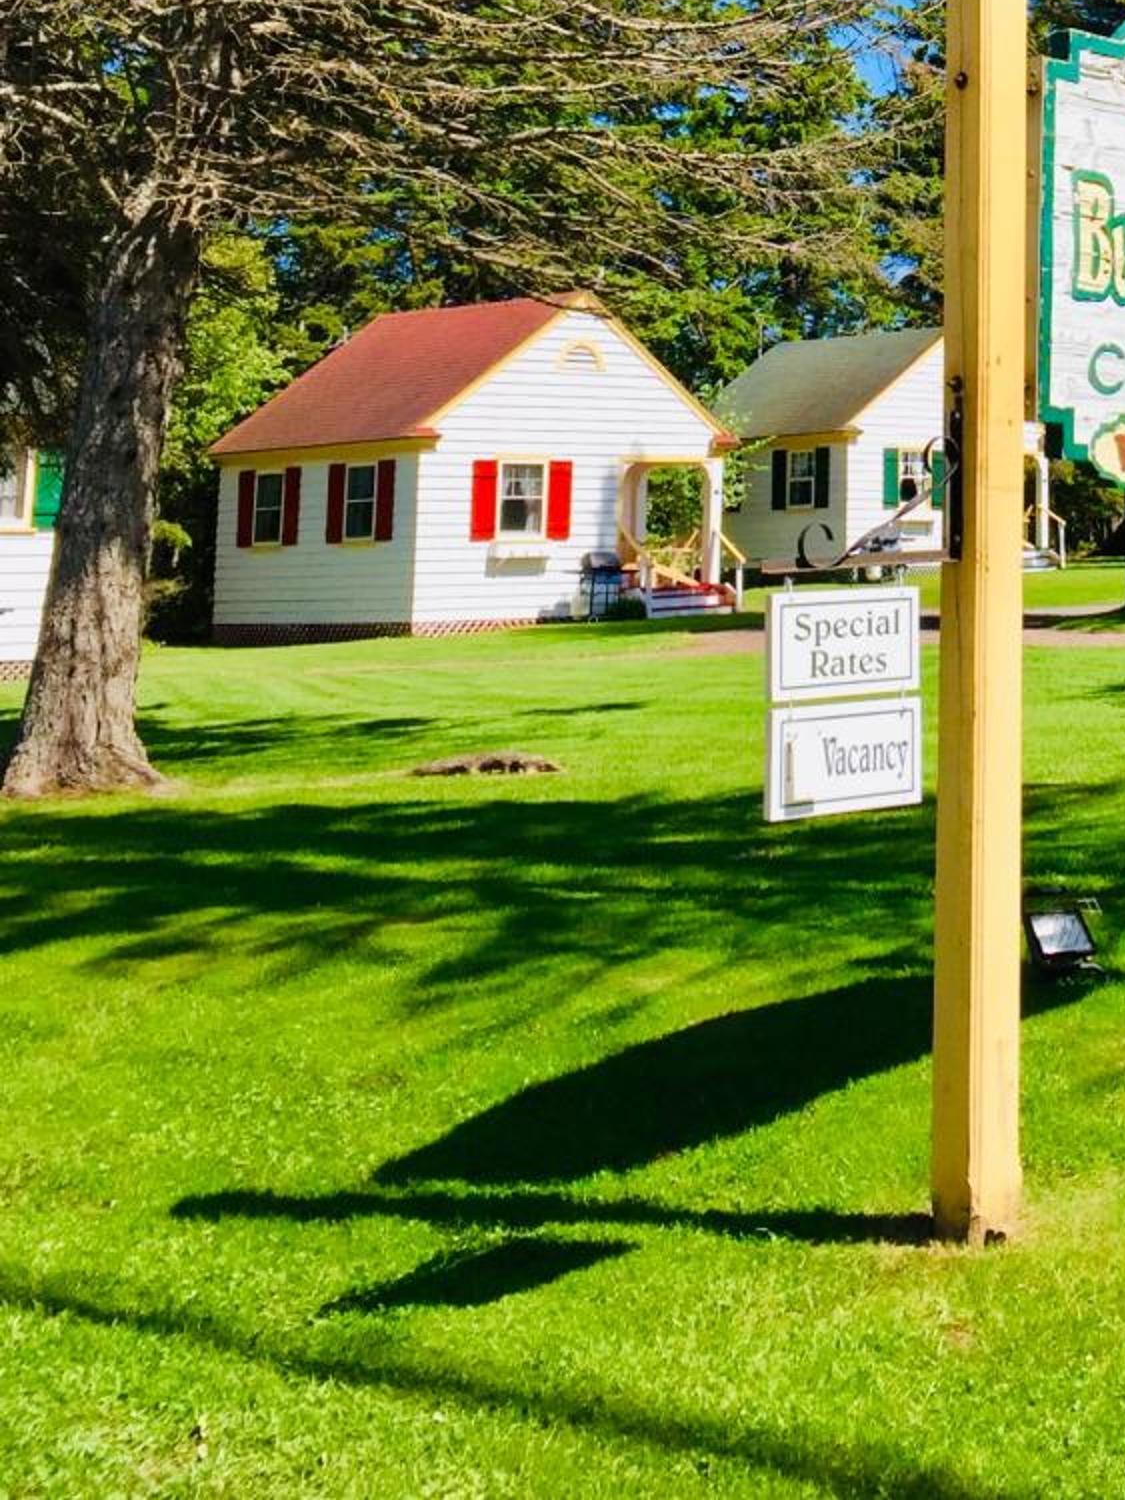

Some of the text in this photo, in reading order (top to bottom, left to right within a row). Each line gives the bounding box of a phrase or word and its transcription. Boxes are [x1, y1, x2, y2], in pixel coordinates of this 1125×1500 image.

[794, 609, 900, 646] Special
[810, 650, 888, 678] Rates
[822, 736, 908, 779] Vacancy
